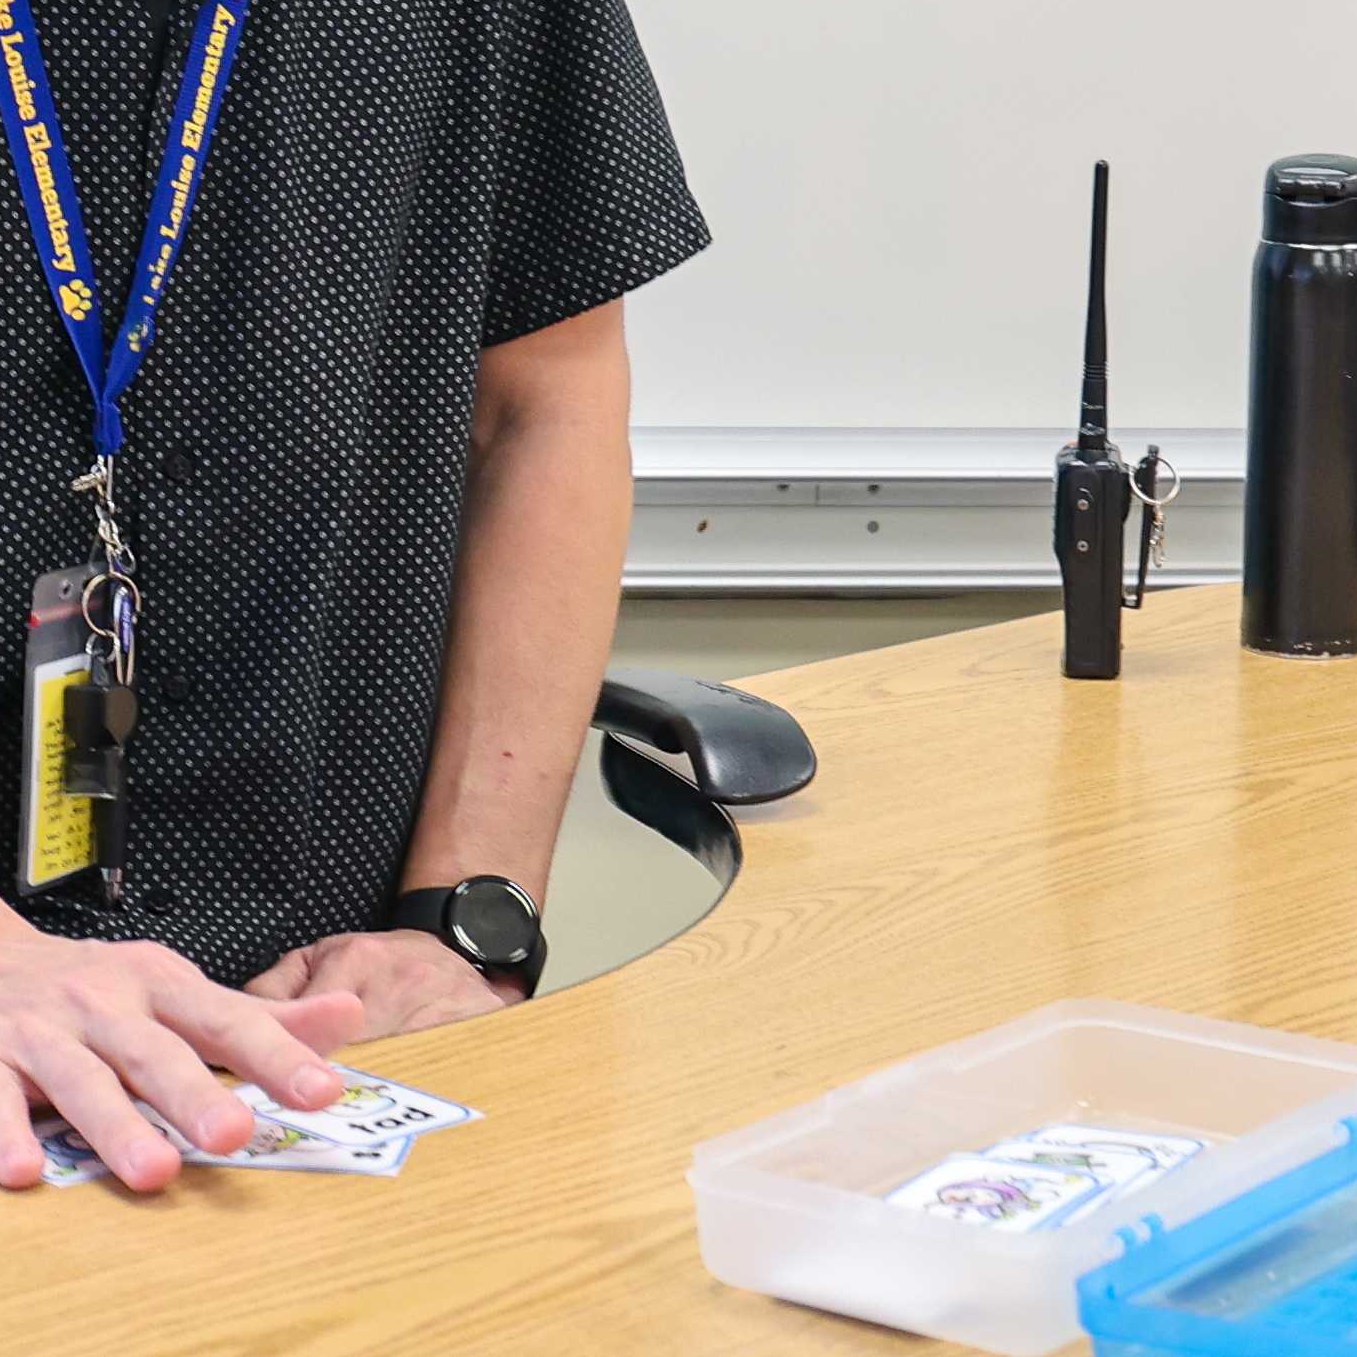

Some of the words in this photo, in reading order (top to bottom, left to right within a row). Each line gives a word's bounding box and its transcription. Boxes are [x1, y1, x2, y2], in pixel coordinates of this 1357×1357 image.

[0, 31, 36, 121] Louise
[23, 121, 76, 273] Elementary
[159, 154, 197, 241] Louise
[180, 3, 237, 153] Elementary
